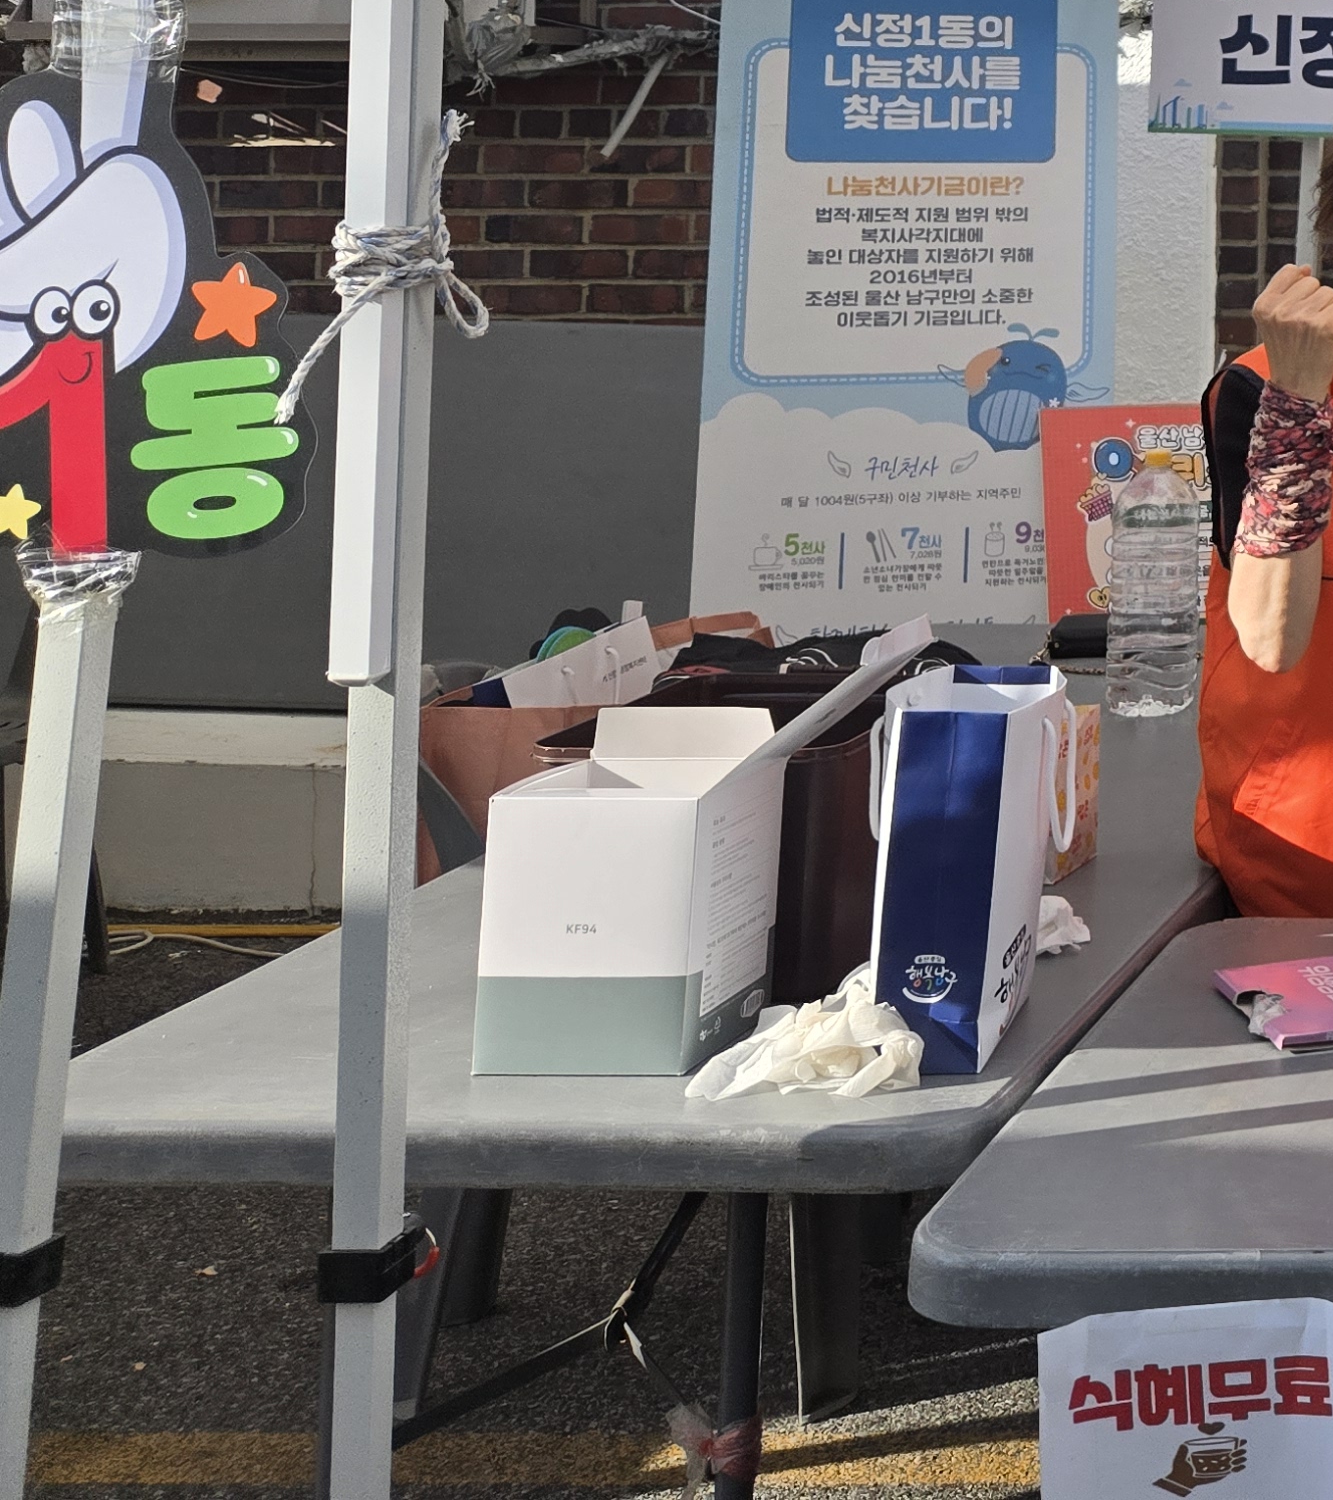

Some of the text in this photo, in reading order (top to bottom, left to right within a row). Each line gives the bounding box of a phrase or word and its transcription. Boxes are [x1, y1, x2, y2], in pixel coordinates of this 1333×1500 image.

[834, 12, 1015, 50] 신정1동의
[824, 54, 1022, 92] 나눔천사를
[841, 94, 1013, 132] 찾습니다!
[826, 175, 1025, 197] 나눔천사기금이란?
[815, 206, 1029, 224] 법적·제도적 지원 범위 밖의
[861, 227, 984, 244] 복지사각지대에
[807, 246, 1034, 266] 놓인 대상자를 지원하기 위해
[869, 269, 973, 285] 2016년부터
[805, 287, 1034, 308] 조성된 울산 남구만의 소중한
[836, 308, 1007, 329] 이웃돕기 기금입니다.
[1137, 426, 1179, 449] 울산
[864, 452, 940, 482] 구민천사
[898, 490, 922, 504] 이상
[926, 489, 972, 504] 기부하는
[975, 487, 1022, 501] 지역주민
[900, 526, 943, 551] 7천사
[1014, 520, 1045, 545] 9천
[783, 532, 826, 557] 5천사
[565, 923, 598, 935] KF94
[1066, 1354, 1333, 1433] 식혜무료
